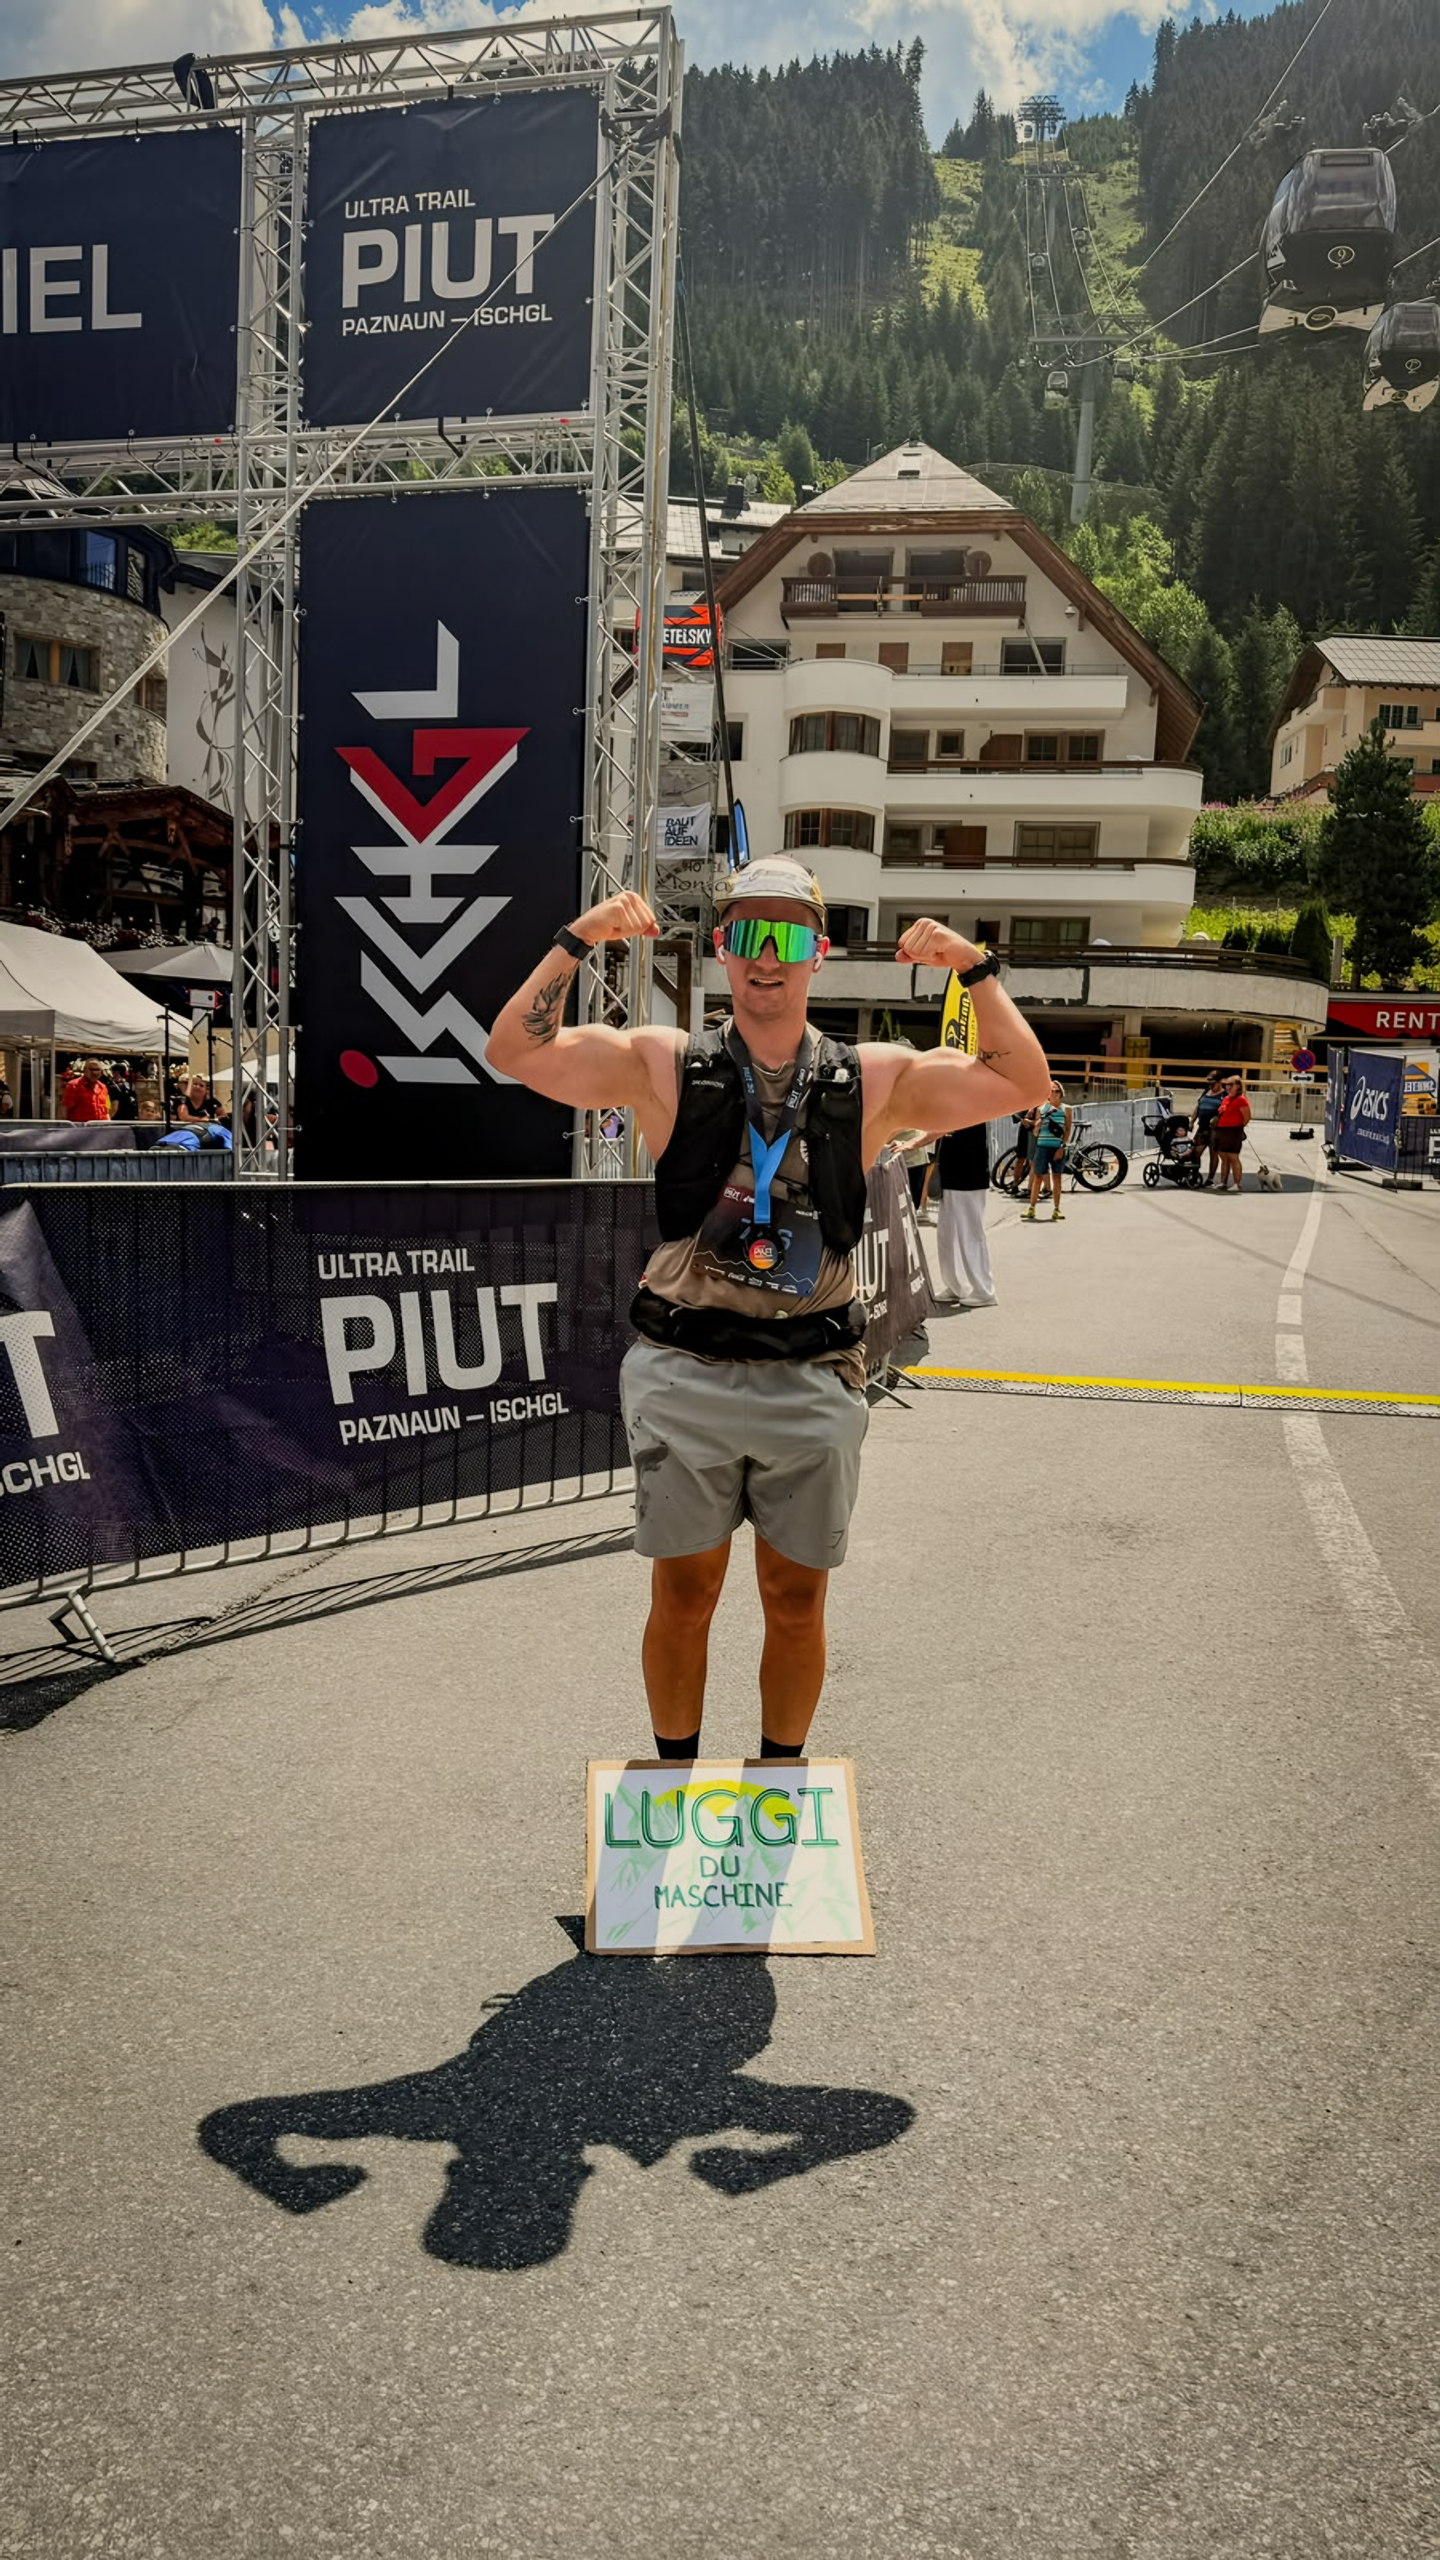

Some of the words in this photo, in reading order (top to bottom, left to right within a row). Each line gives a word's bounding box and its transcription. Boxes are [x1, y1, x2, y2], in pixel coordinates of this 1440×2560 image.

[344, 193, 410, 219] ULTRA
[415, 188, 476, 211] TRAIL
[341, 213, 556, 309] PIUT
[2, 244, 142, 334] IEL
[342, 308, 446, 337] PAZNAUN
[473, 303, 553, 327] ISCHGL
[664, 835, 699, 847] IDEEN
[1376, 1010, 1440, 1030] RENT
[317, 1250, 402, 1281] ULTRA
[406, 1248, 475, 1275] TRAIL
[320, 1282, 558, 1405] PIUT
[339, 1404, 460, 1446] PAZNAUN
[489, 1391, 569, 1424] ISCHGL
[0, 1451, 91, 1496] CHGL
[604, 1787, 841, 1848] LUGGI
[699, 1854, 741, 1879] DU
[653, 1882, 793, 1910] MASCHINE
